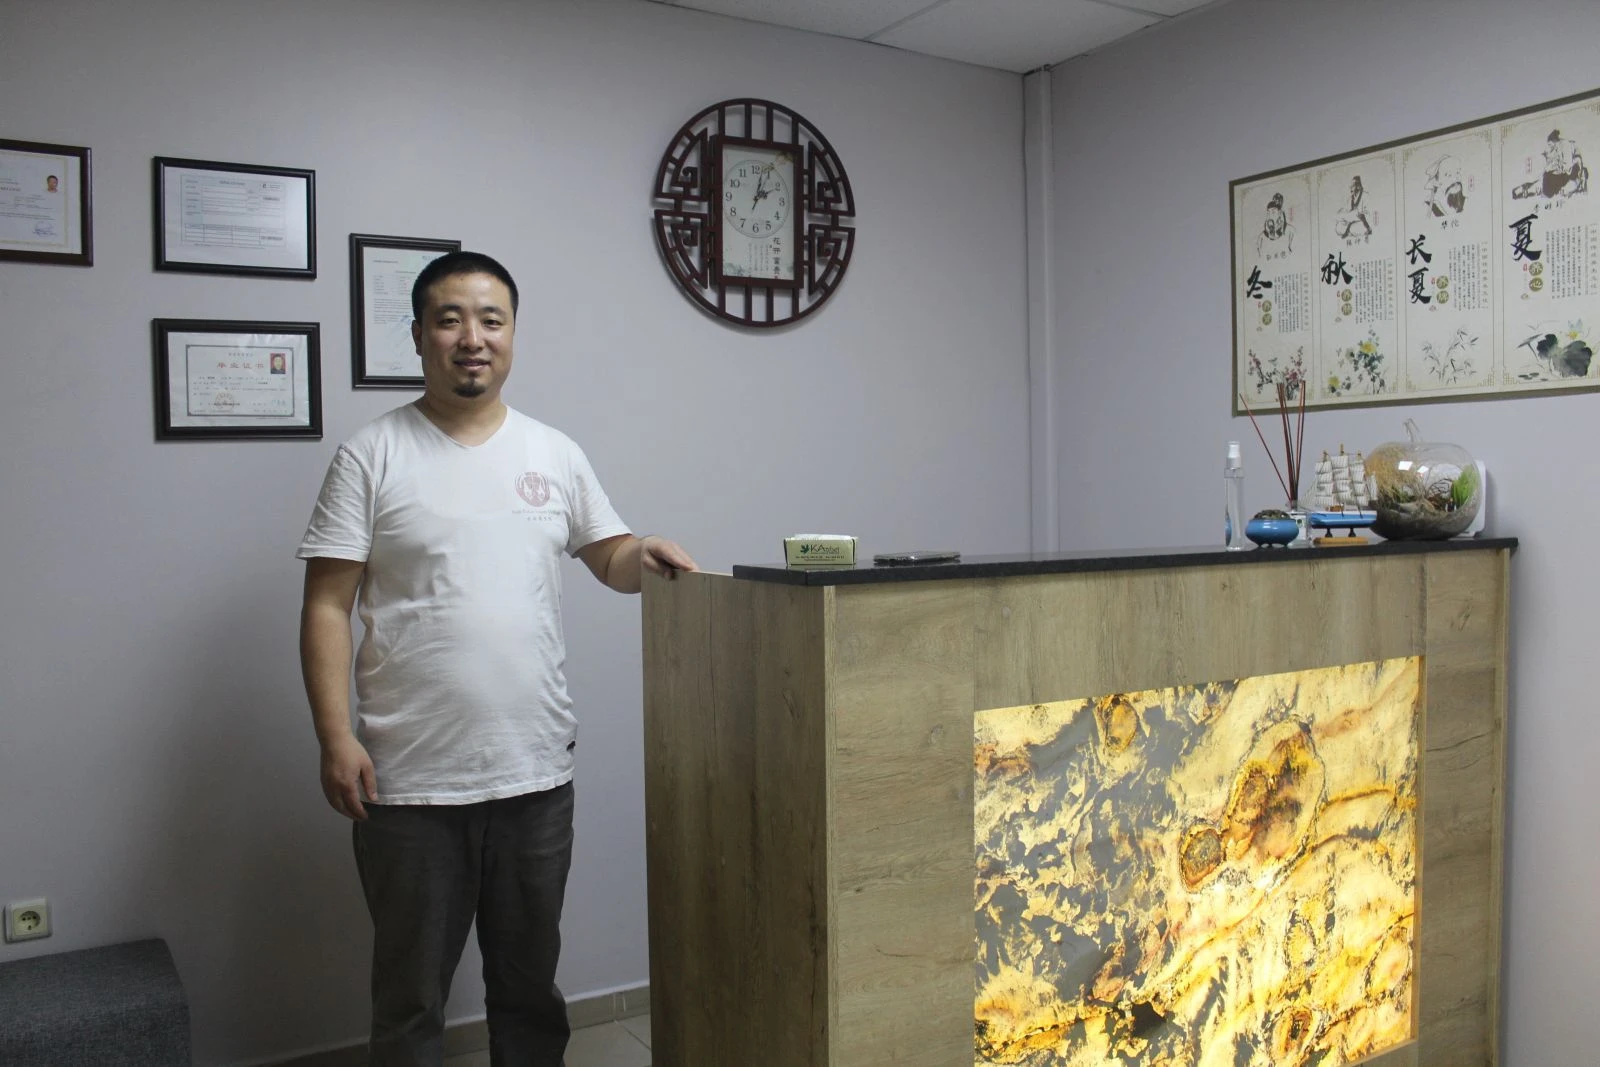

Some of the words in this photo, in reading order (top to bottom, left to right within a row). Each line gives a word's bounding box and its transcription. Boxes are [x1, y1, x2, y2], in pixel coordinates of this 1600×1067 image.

[738, 168, 747, 177] 11
[752, 165, 761, 175] 12
[729, 179, 741, 188] 10
[775, 182, 781, 191] 2
[725, 192, 732, 201] 9
[779, 198, 786, 207] 3
[730, 207, 737, 216] 8
[774, 211, 781, 220] 4
[739, 219, 747, 228] 7
[752, 223, 759, 233] 6
[765, 221, 771, 230] 5
[1508, 213, 1543, 262] 夏
[1321, 251, 1354, 286] 秋
[1246, 265, 1273, 299] 冬
[216, 361, 264, 370] 毕业证书
